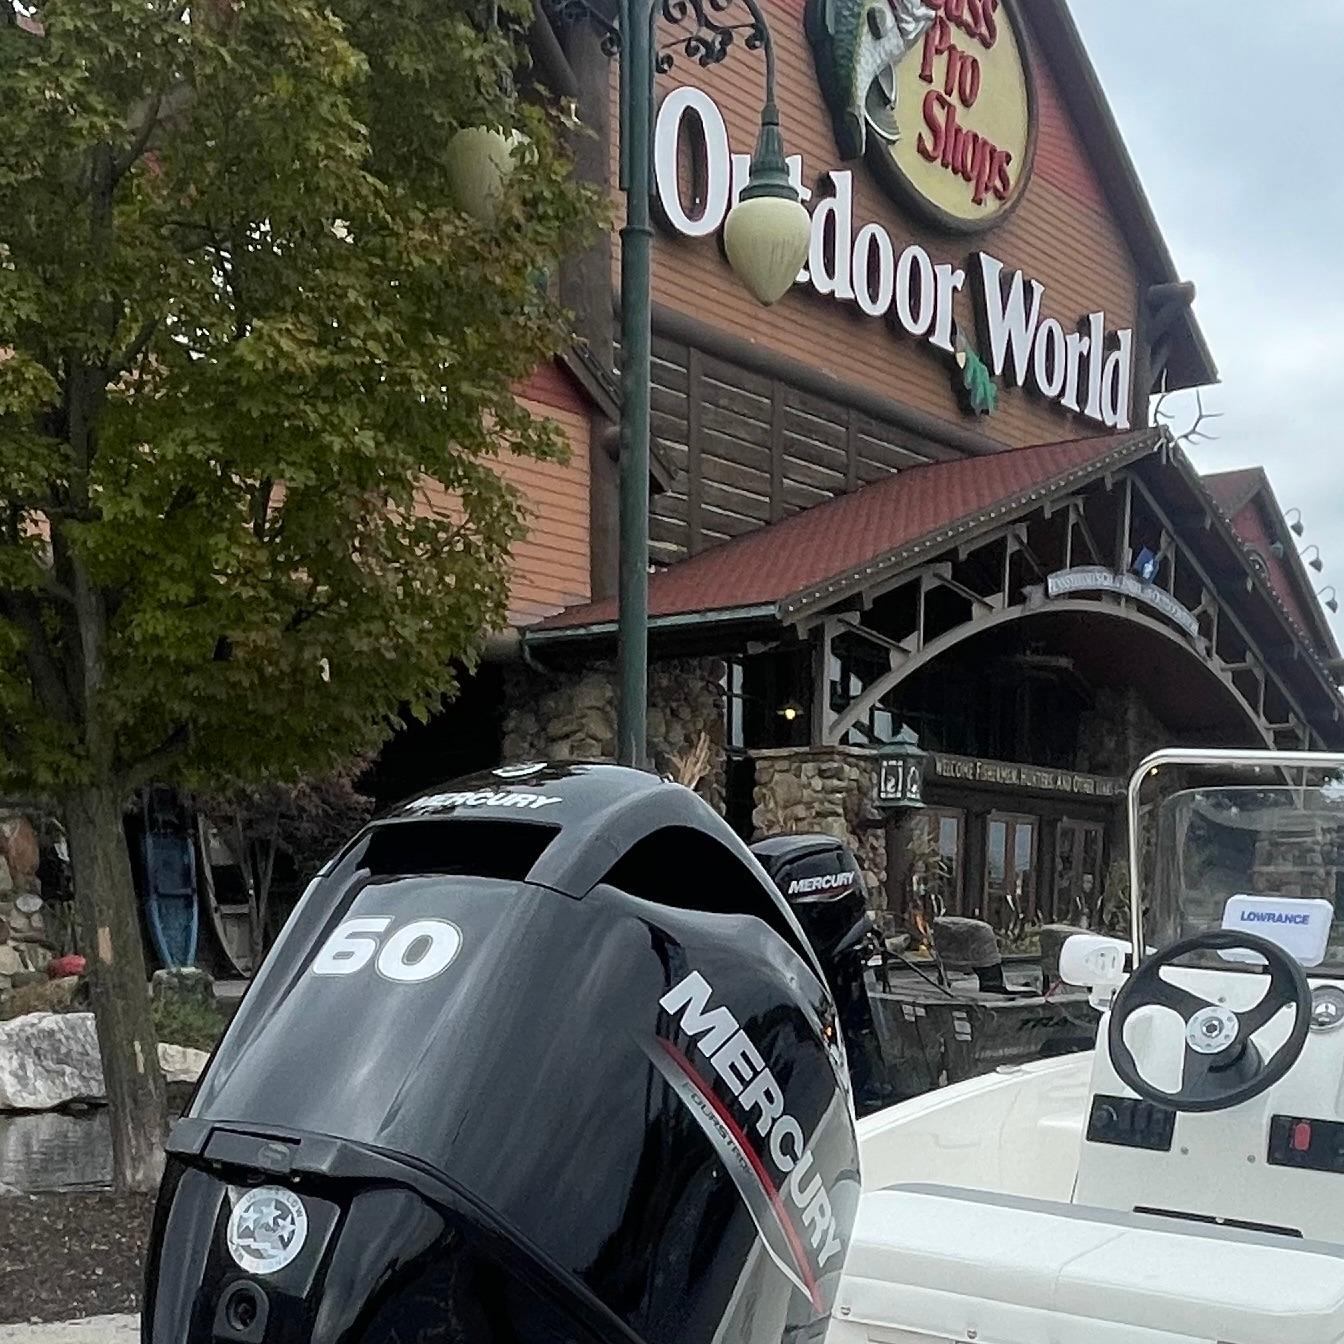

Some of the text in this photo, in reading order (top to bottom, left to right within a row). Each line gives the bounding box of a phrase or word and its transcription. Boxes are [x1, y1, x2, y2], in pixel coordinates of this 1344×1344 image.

[919, 15, 981, 108] Pro
[922, 0, 999, 49] ss
[917, 89, 1013, 206] Shops
[654, 85, 1132, 430] Odoor World
[403, 791, 563, 813] MERCURY
[787, 871, 855, 895] MERCURY
[1240, 910, 1310, 925] LOWRANCE
[312, 915, 463, 983] 60
[659, 970, 842, 1268] MERCURY
[681, 1080, 757, 1178] FOURSTROK
